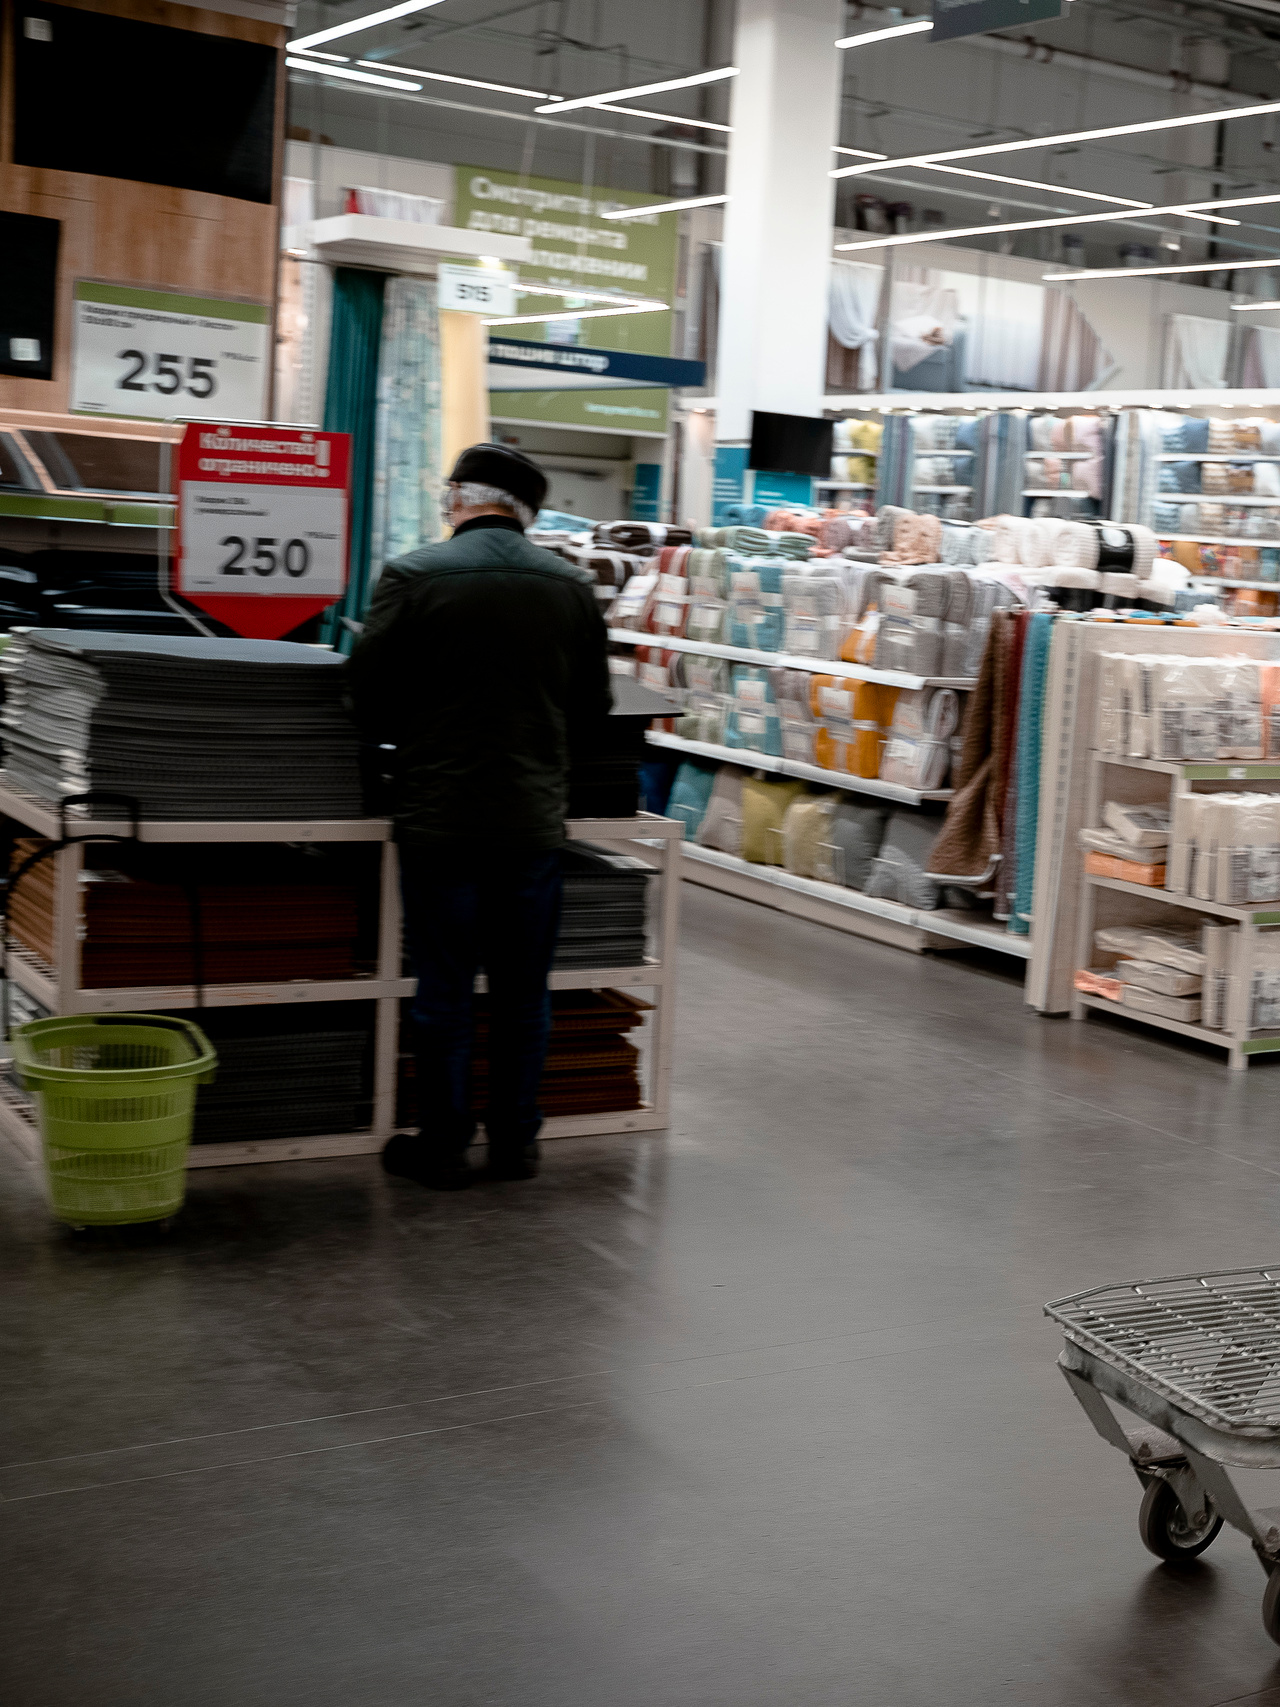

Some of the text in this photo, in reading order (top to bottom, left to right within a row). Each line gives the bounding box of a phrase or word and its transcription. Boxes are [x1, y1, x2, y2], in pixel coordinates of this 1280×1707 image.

[468, 210, 629, 250] для ремонта
[117, 350, 218, 398] 255
[198, 432, 317, 456] Количество
[219, 536, 311, 578] 250
